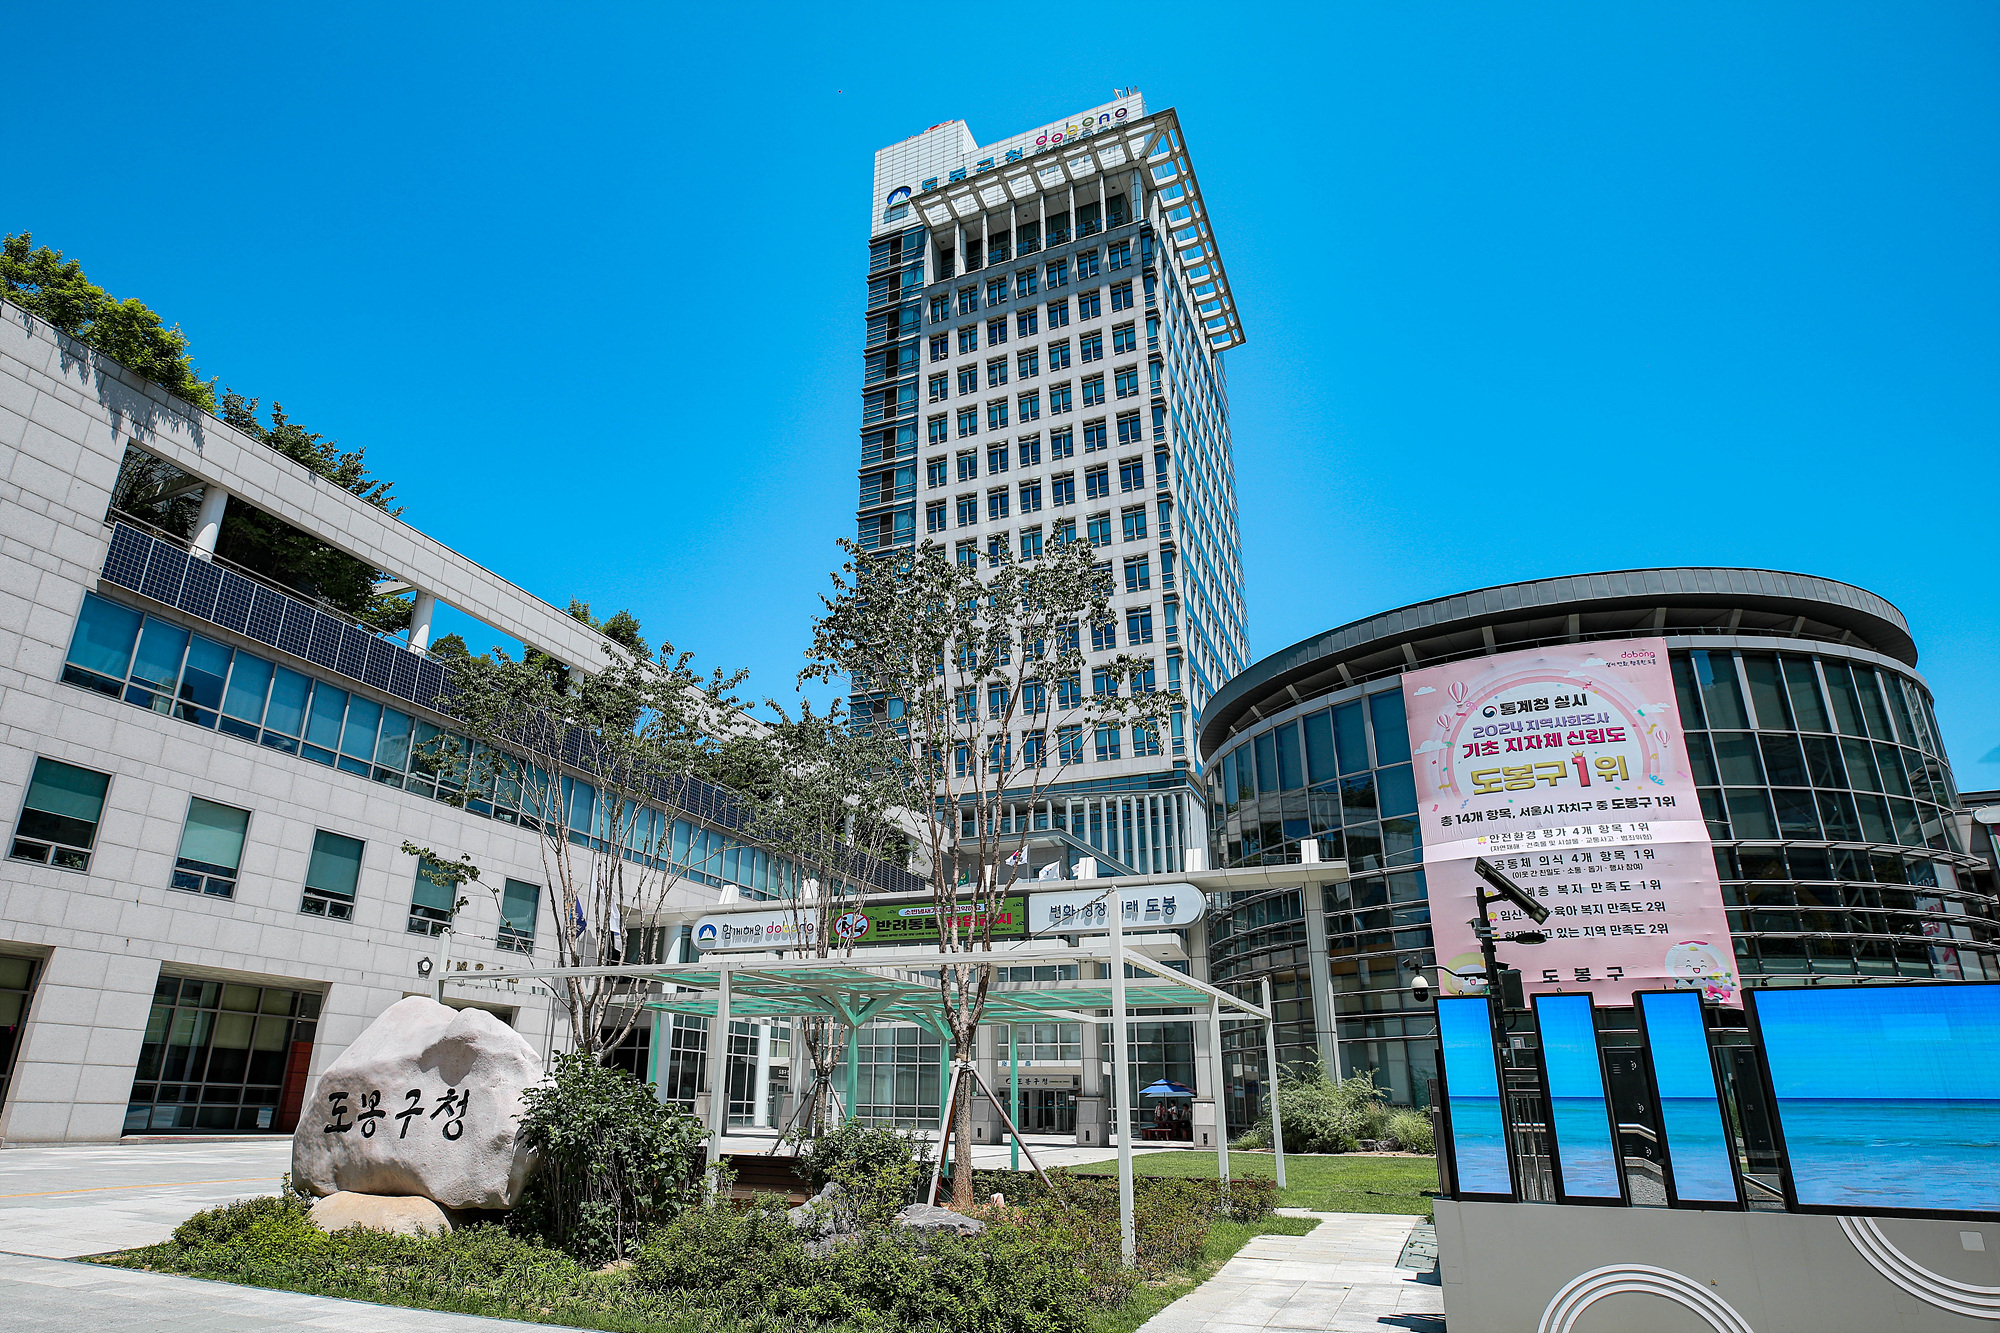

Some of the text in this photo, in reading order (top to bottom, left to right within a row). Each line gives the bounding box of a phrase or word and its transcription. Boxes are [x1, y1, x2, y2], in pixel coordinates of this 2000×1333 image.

[1036, 108, 1128, 146] dobong
[1621, 651, 1656, 659] dobong
[1500, 693, 1588, 716] 통계청 실시
[1472, 711, 1610, 739] 2024 지역사회조사
[1462, 726, 1627, 758] 기초 지자체 신뢰도
[1470, 760, 1568, 796] 도봉구
[1440, 795, 1676, 827] 총 14개 항목, 서울시 자치구 중 도봉구 1위
[1489, 822, 1650, 844] 안전환경 평가 4개 항목 1위
[1494, 848, 1655, 871] 공동체 의식 4개 항목 1위
[1557, 883, 1583, 895] 복지
[1590, 880, 1632, 894] 만족도
[1639, 879, 1662, 891] 1위
[1145, 896, 1178, 916] 도봉
[1580, 903, 1604, 916] 복지
[1607, 901, 1644, 914] 만족도
[1645, 900, 1666, 912] 2위
[1556, 927, 1580, 939] 있는
[1583, 925, 1607, 937] 지역
[1609, 923, 1646, 936] 만족도
[1648, 922, 1669, 934] 2위
[1541, 966, 1625, 984] 도봉구
[323, 1088, 470, 1141] 도봉구청
